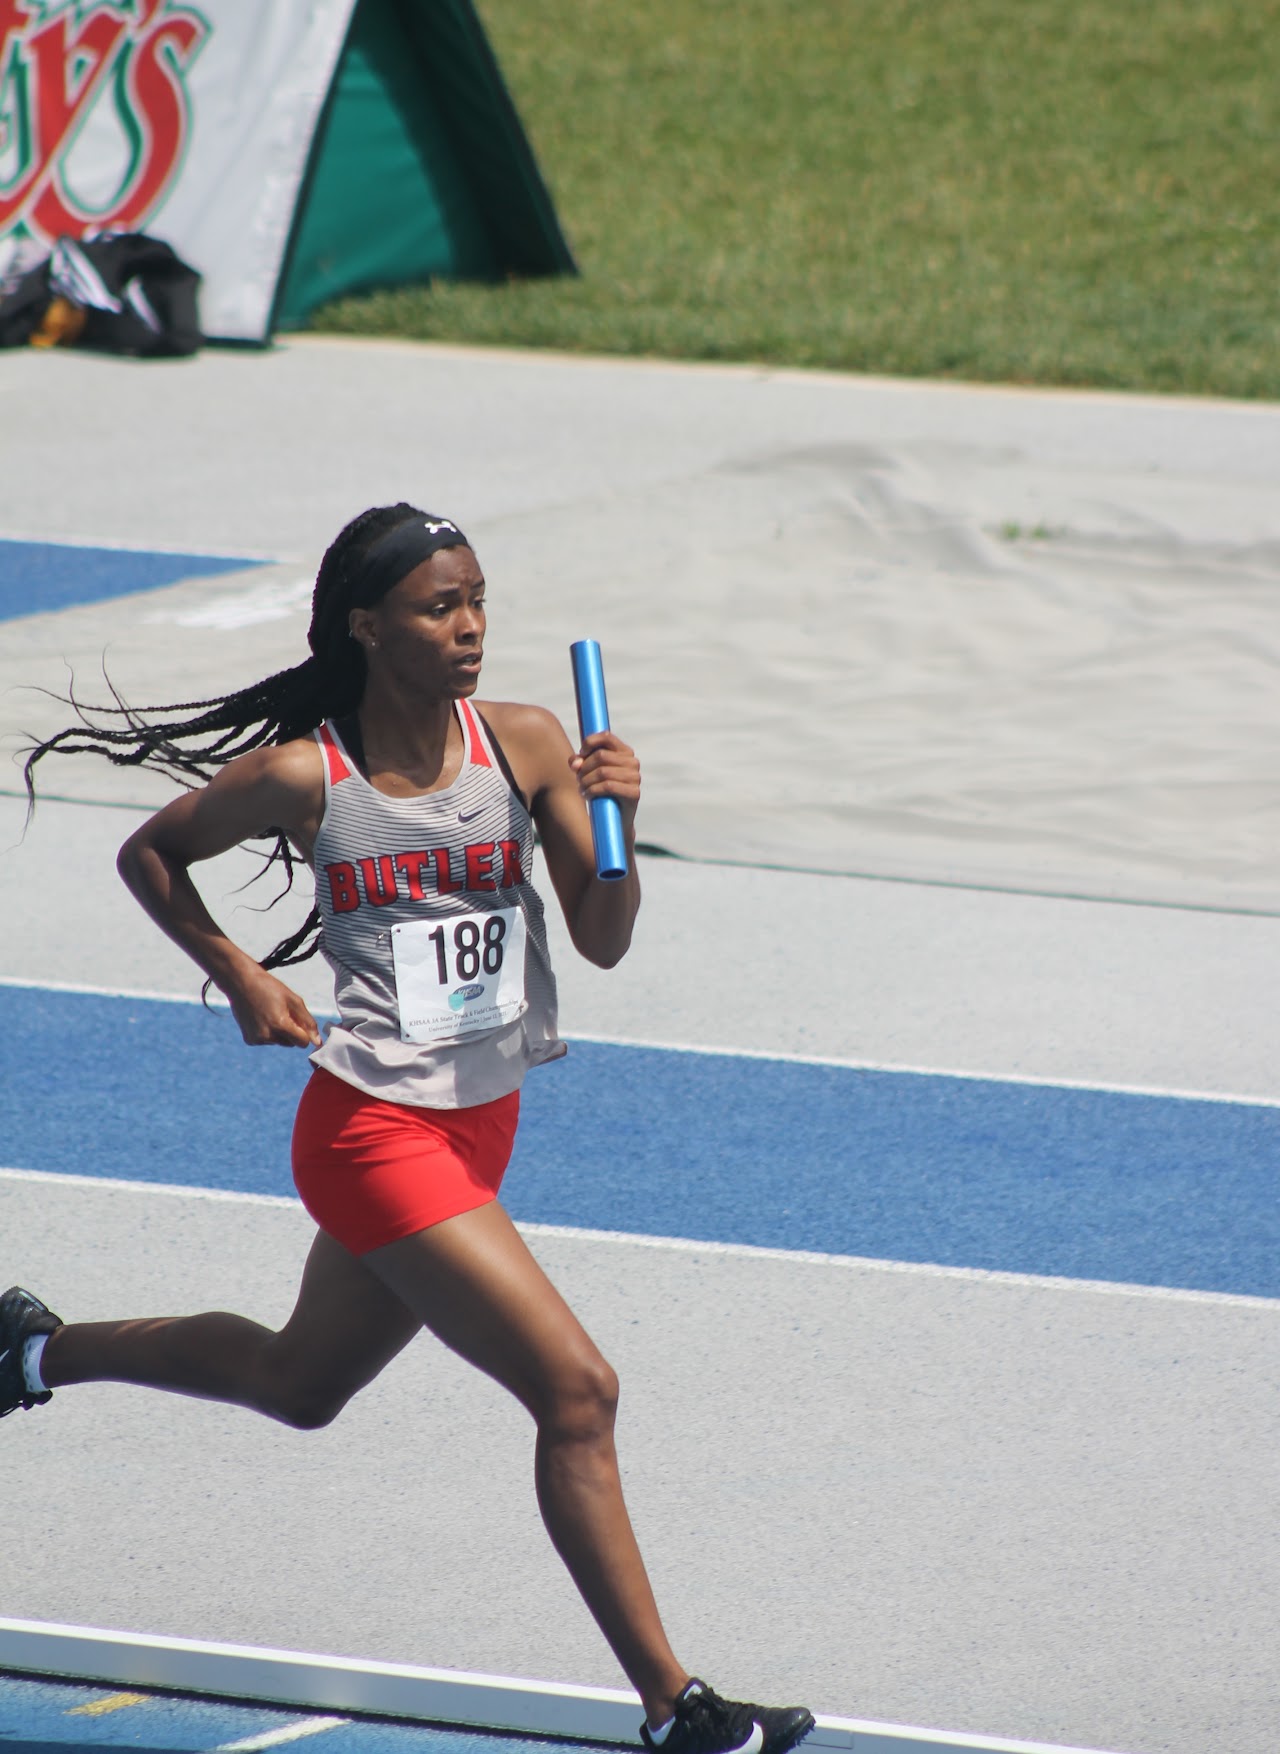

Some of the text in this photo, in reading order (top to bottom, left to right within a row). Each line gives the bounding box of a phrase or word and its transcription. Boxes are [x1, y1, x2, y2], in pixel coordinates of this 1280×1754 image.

[324, 839, 524, 913] BUTLER
[428, 915, 506, 985] 188
[459, 1019, 480, 1027] Kentucky
